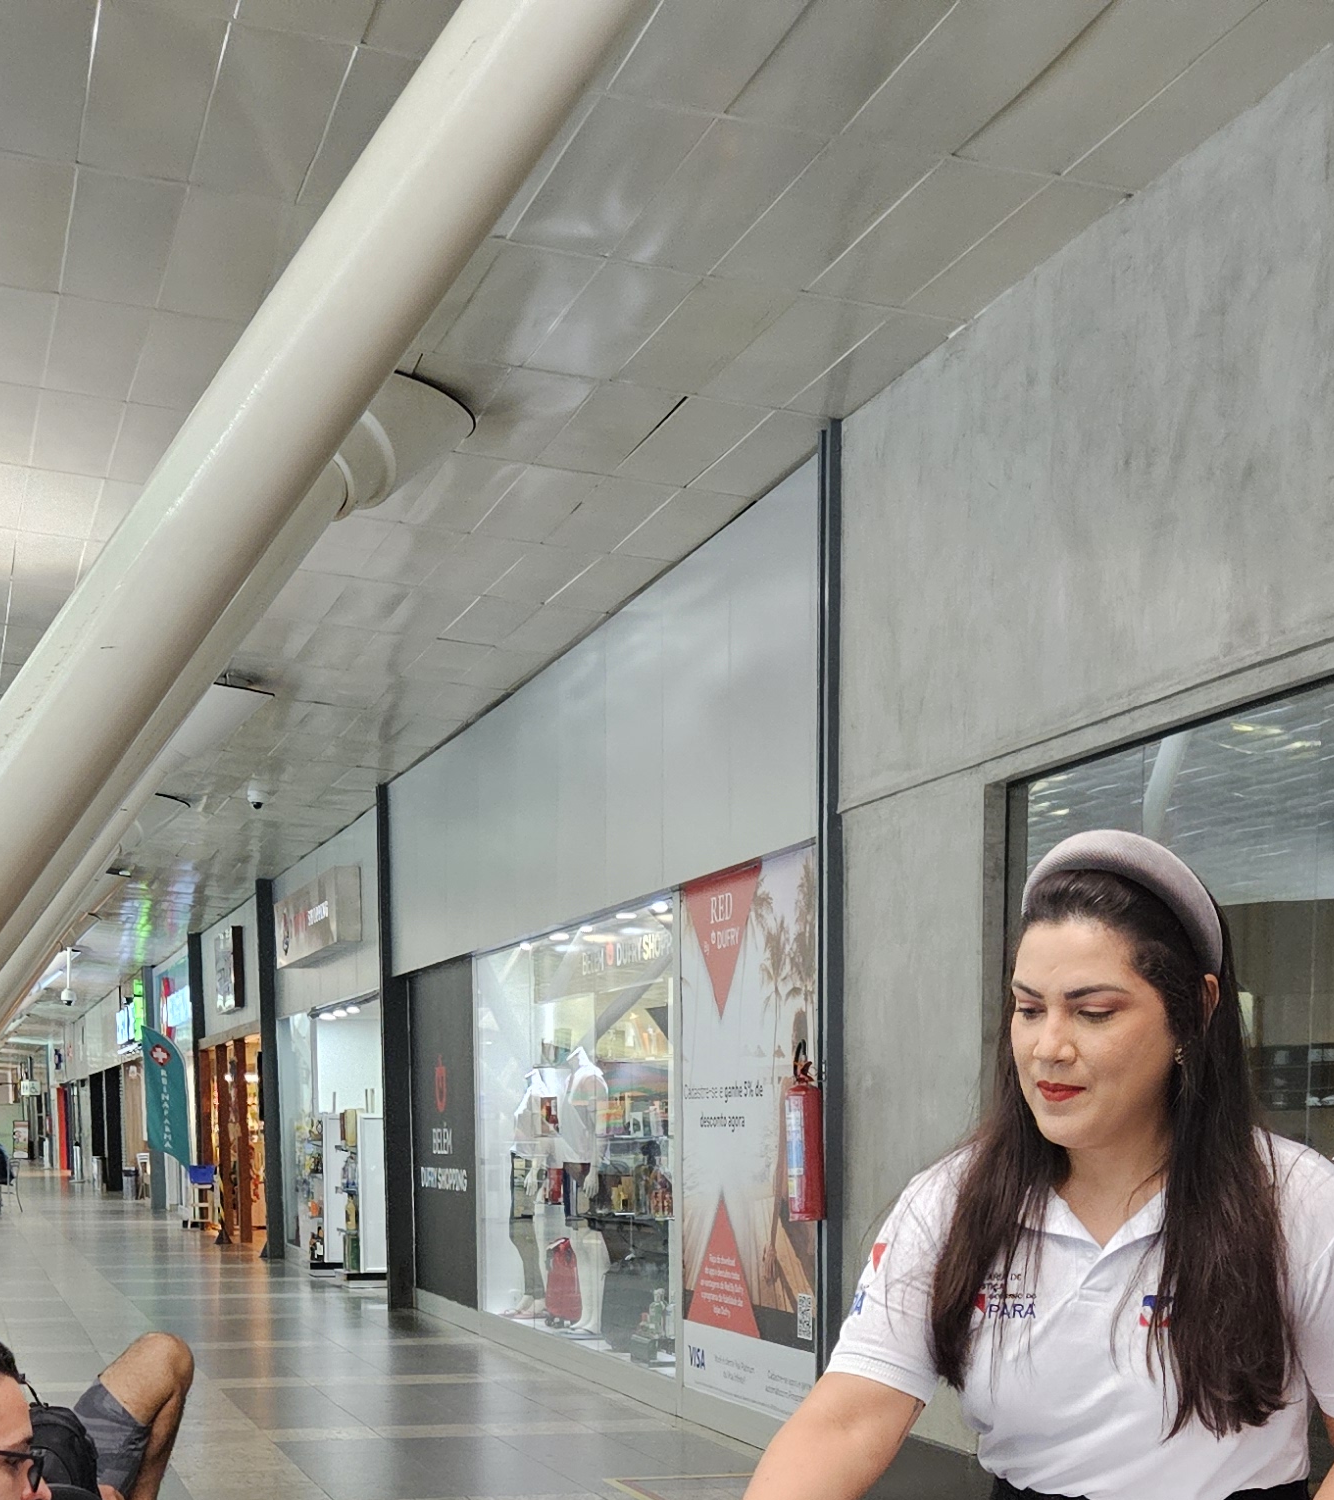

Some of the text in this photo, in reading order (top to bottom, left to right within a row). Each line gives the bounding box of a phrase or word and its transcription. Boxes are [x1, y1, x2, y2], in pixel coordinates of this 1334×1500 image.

[710, 892, 733, 924] RED
[717, 927, 740, 950] DUFRY
[616, 936, 643, 967] DUFRY
[724, 1081, 743, 1103] ganhe
[744, 1080, 754, 1097] 5%
[755, 1080, 764, 1097] de
[700, 1111, 745, 1132] desconto agora
[432, 1121, 453, 1155] BELÉM
[420, 1166, 468, 1192] DUFRY SHOPPING
[1010, 1272, 1022, 1282] DE
[688, 1345, 706, 1370] VISA
